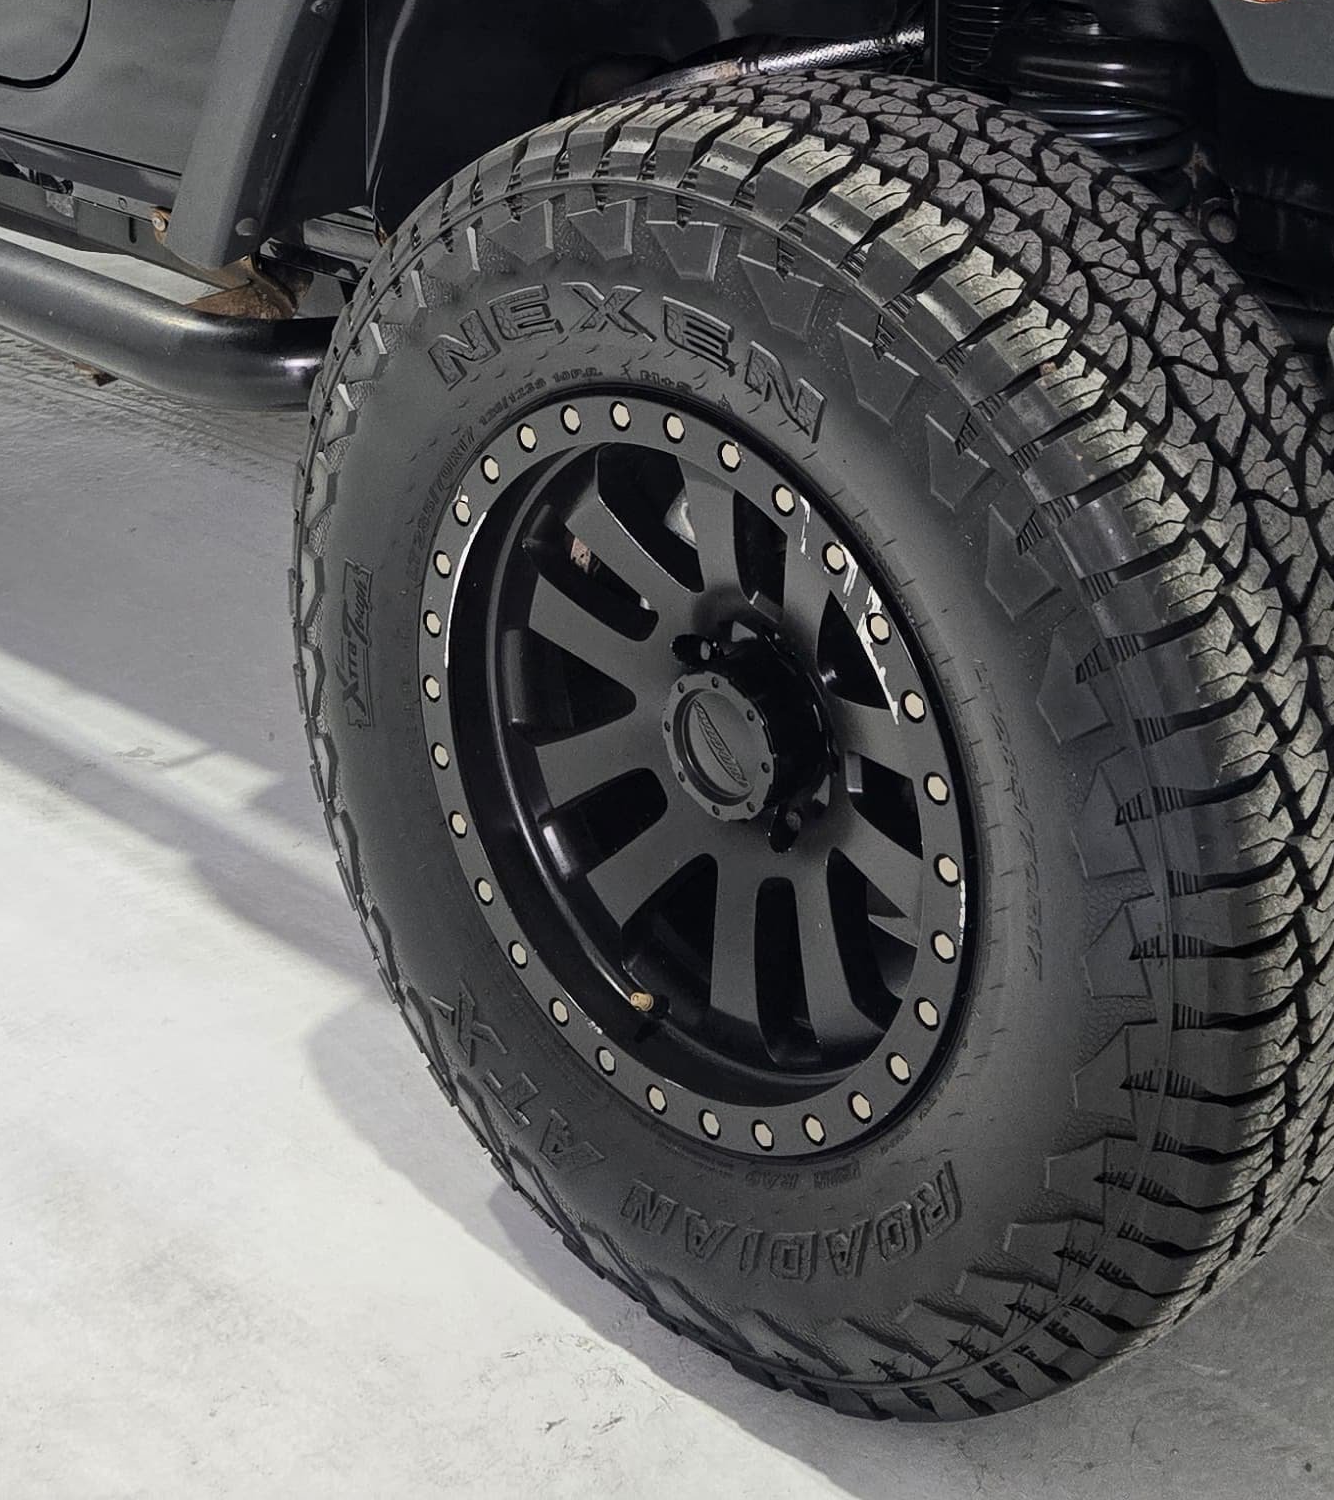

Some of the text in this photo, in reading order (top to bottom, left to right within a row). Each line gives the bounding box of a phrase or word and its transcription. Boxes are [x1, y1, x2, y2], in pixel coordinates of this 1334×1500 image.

[427, 282, 828, 444] NEXEN
[430, 980, 606, 1173] ATX
[619, 1161, 963, 1283] ROADIAN
